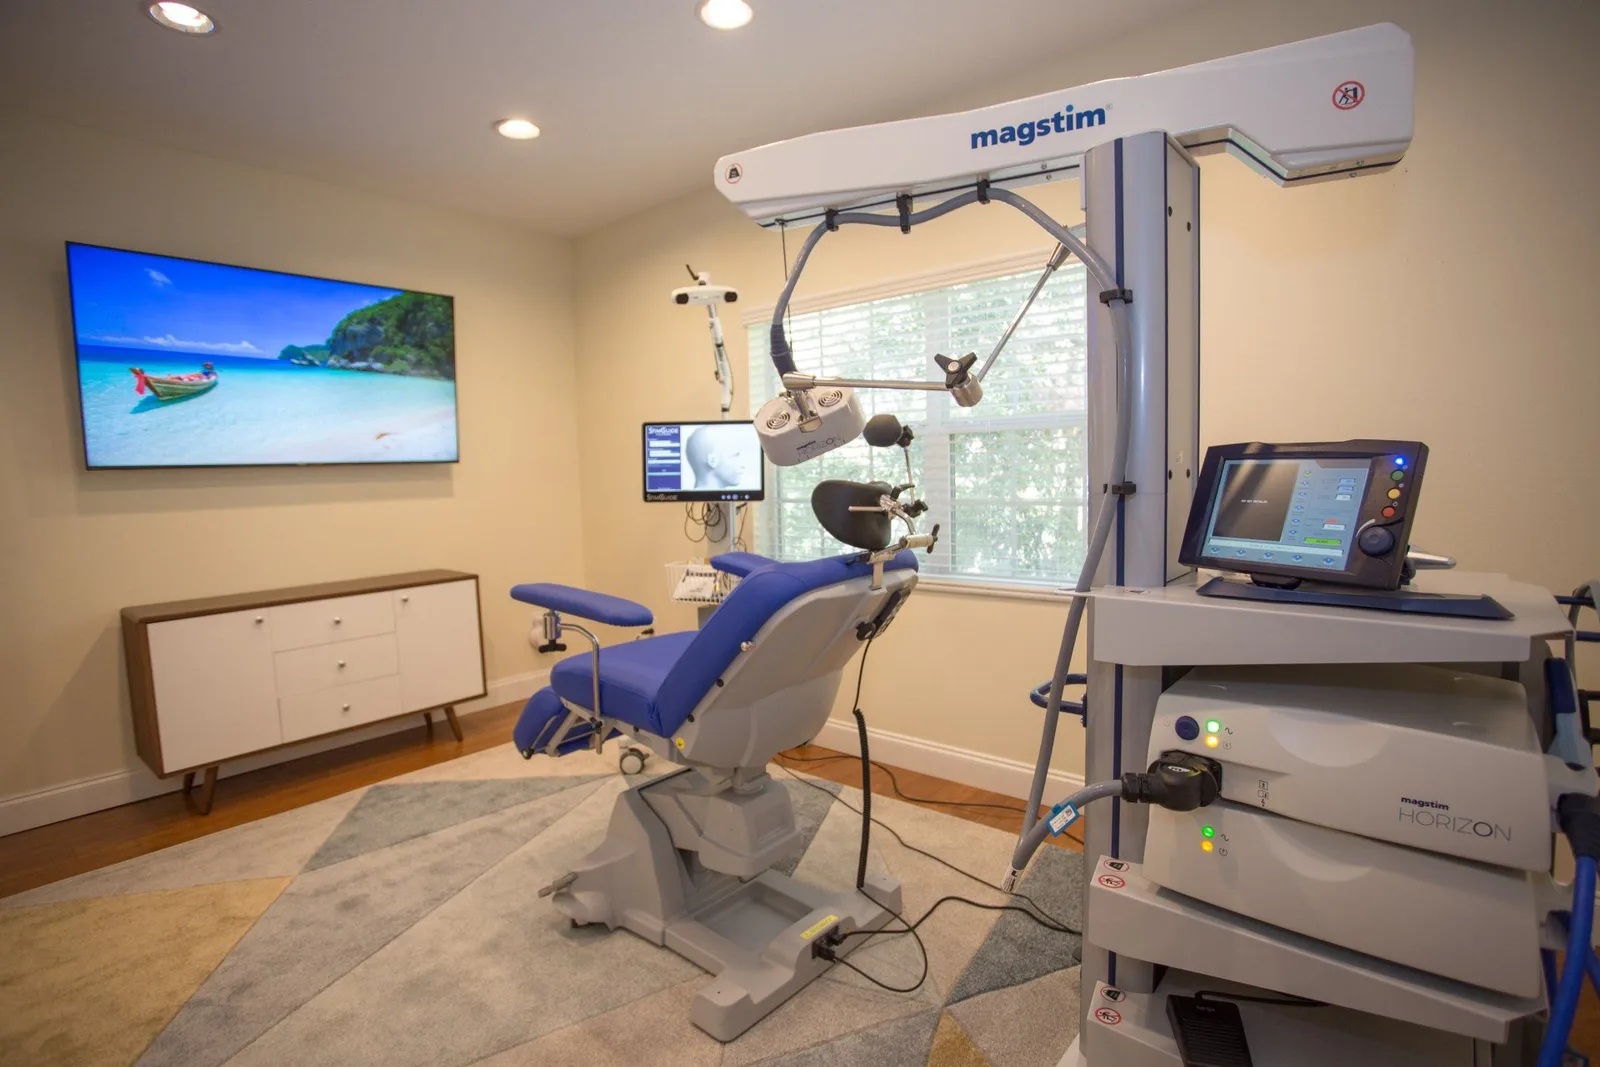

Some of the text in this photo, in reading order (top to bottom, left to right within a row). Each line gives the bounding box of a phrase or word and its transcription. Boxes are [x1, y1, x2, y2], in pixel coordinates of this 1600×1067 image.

[971, 104, 1106, 149] magstim
[1401, 797, 1449, 811] magstim
[1399, 807, 1511, 842] HORIZON
